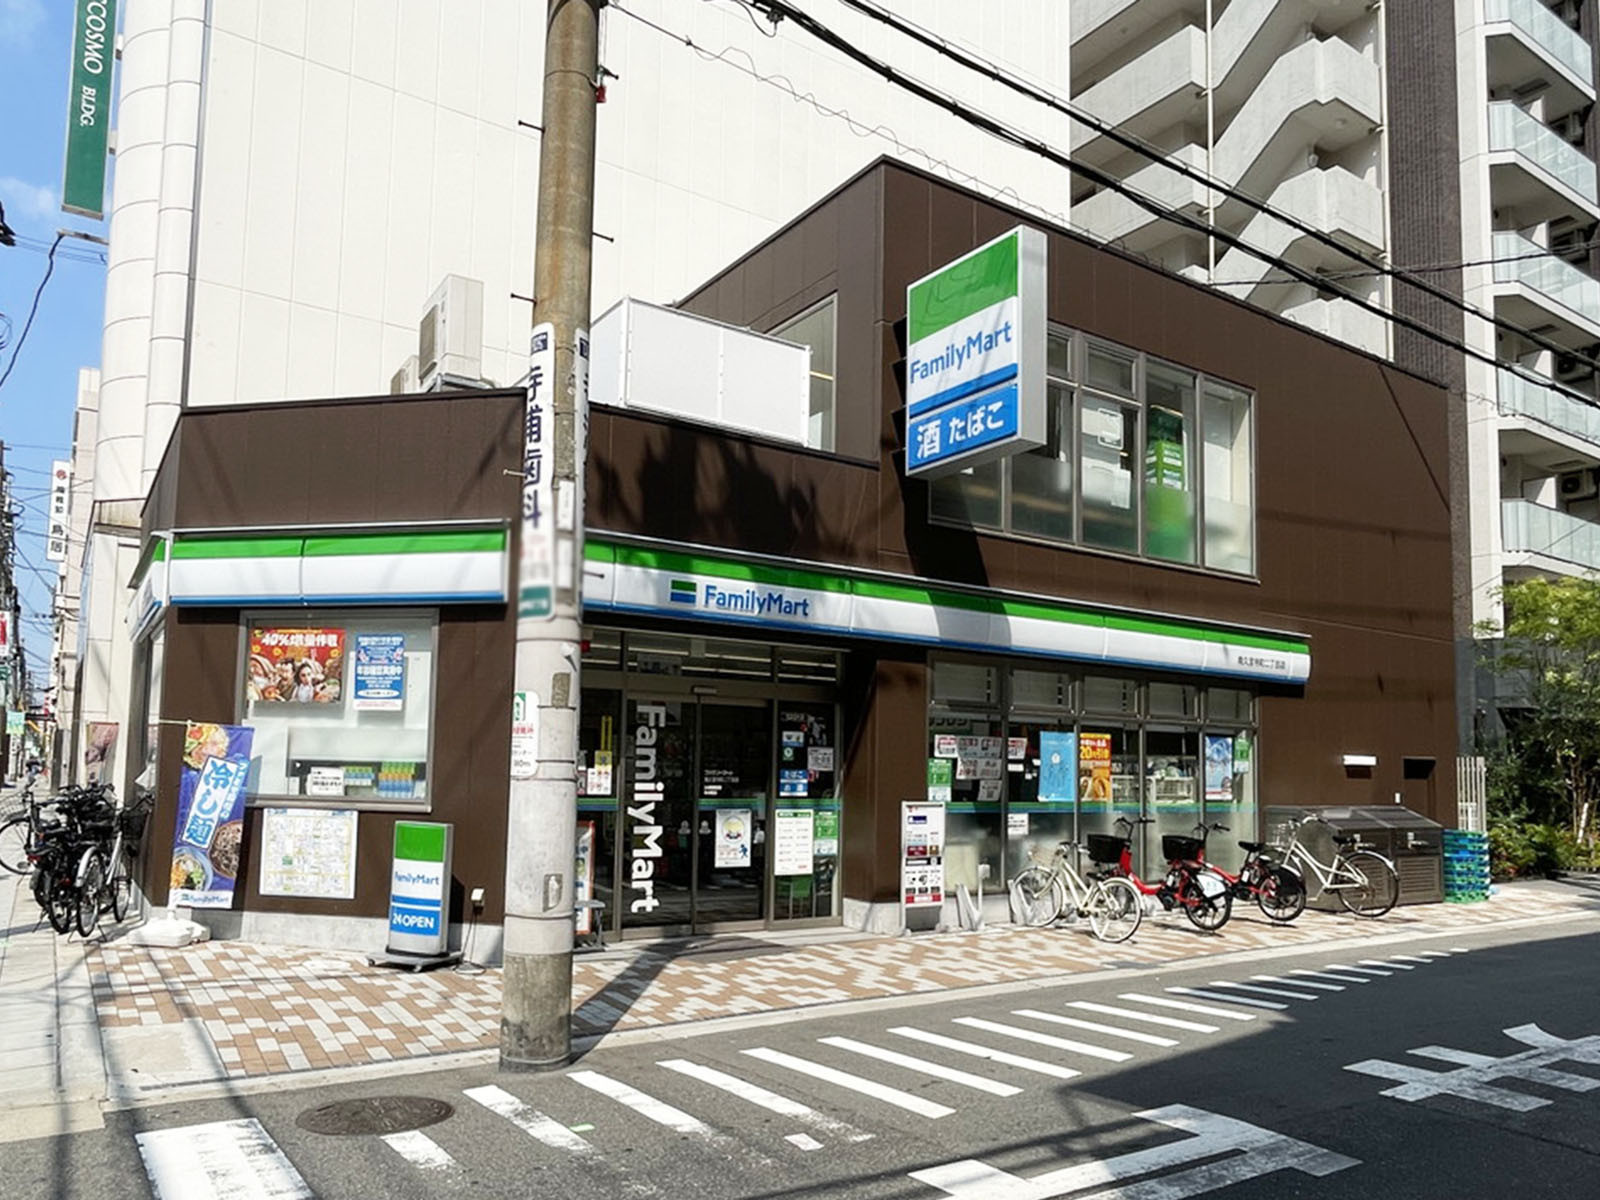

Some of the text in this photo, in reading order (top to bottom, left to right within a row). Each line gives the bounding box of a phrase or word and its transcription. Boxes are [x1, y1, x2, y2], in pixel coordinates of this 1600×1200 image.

[80, 0, 108, 127] COSMO BLDG.
[910, 321, 1012, 384] FamilyMart
[917, 401, 1004, 459] 酒 たばこ
[704, 584, 810, 617] FamilyMart
[185, 758, 235, 847] 冷し麺
[627, 704, 668, 914] FamilyMart
